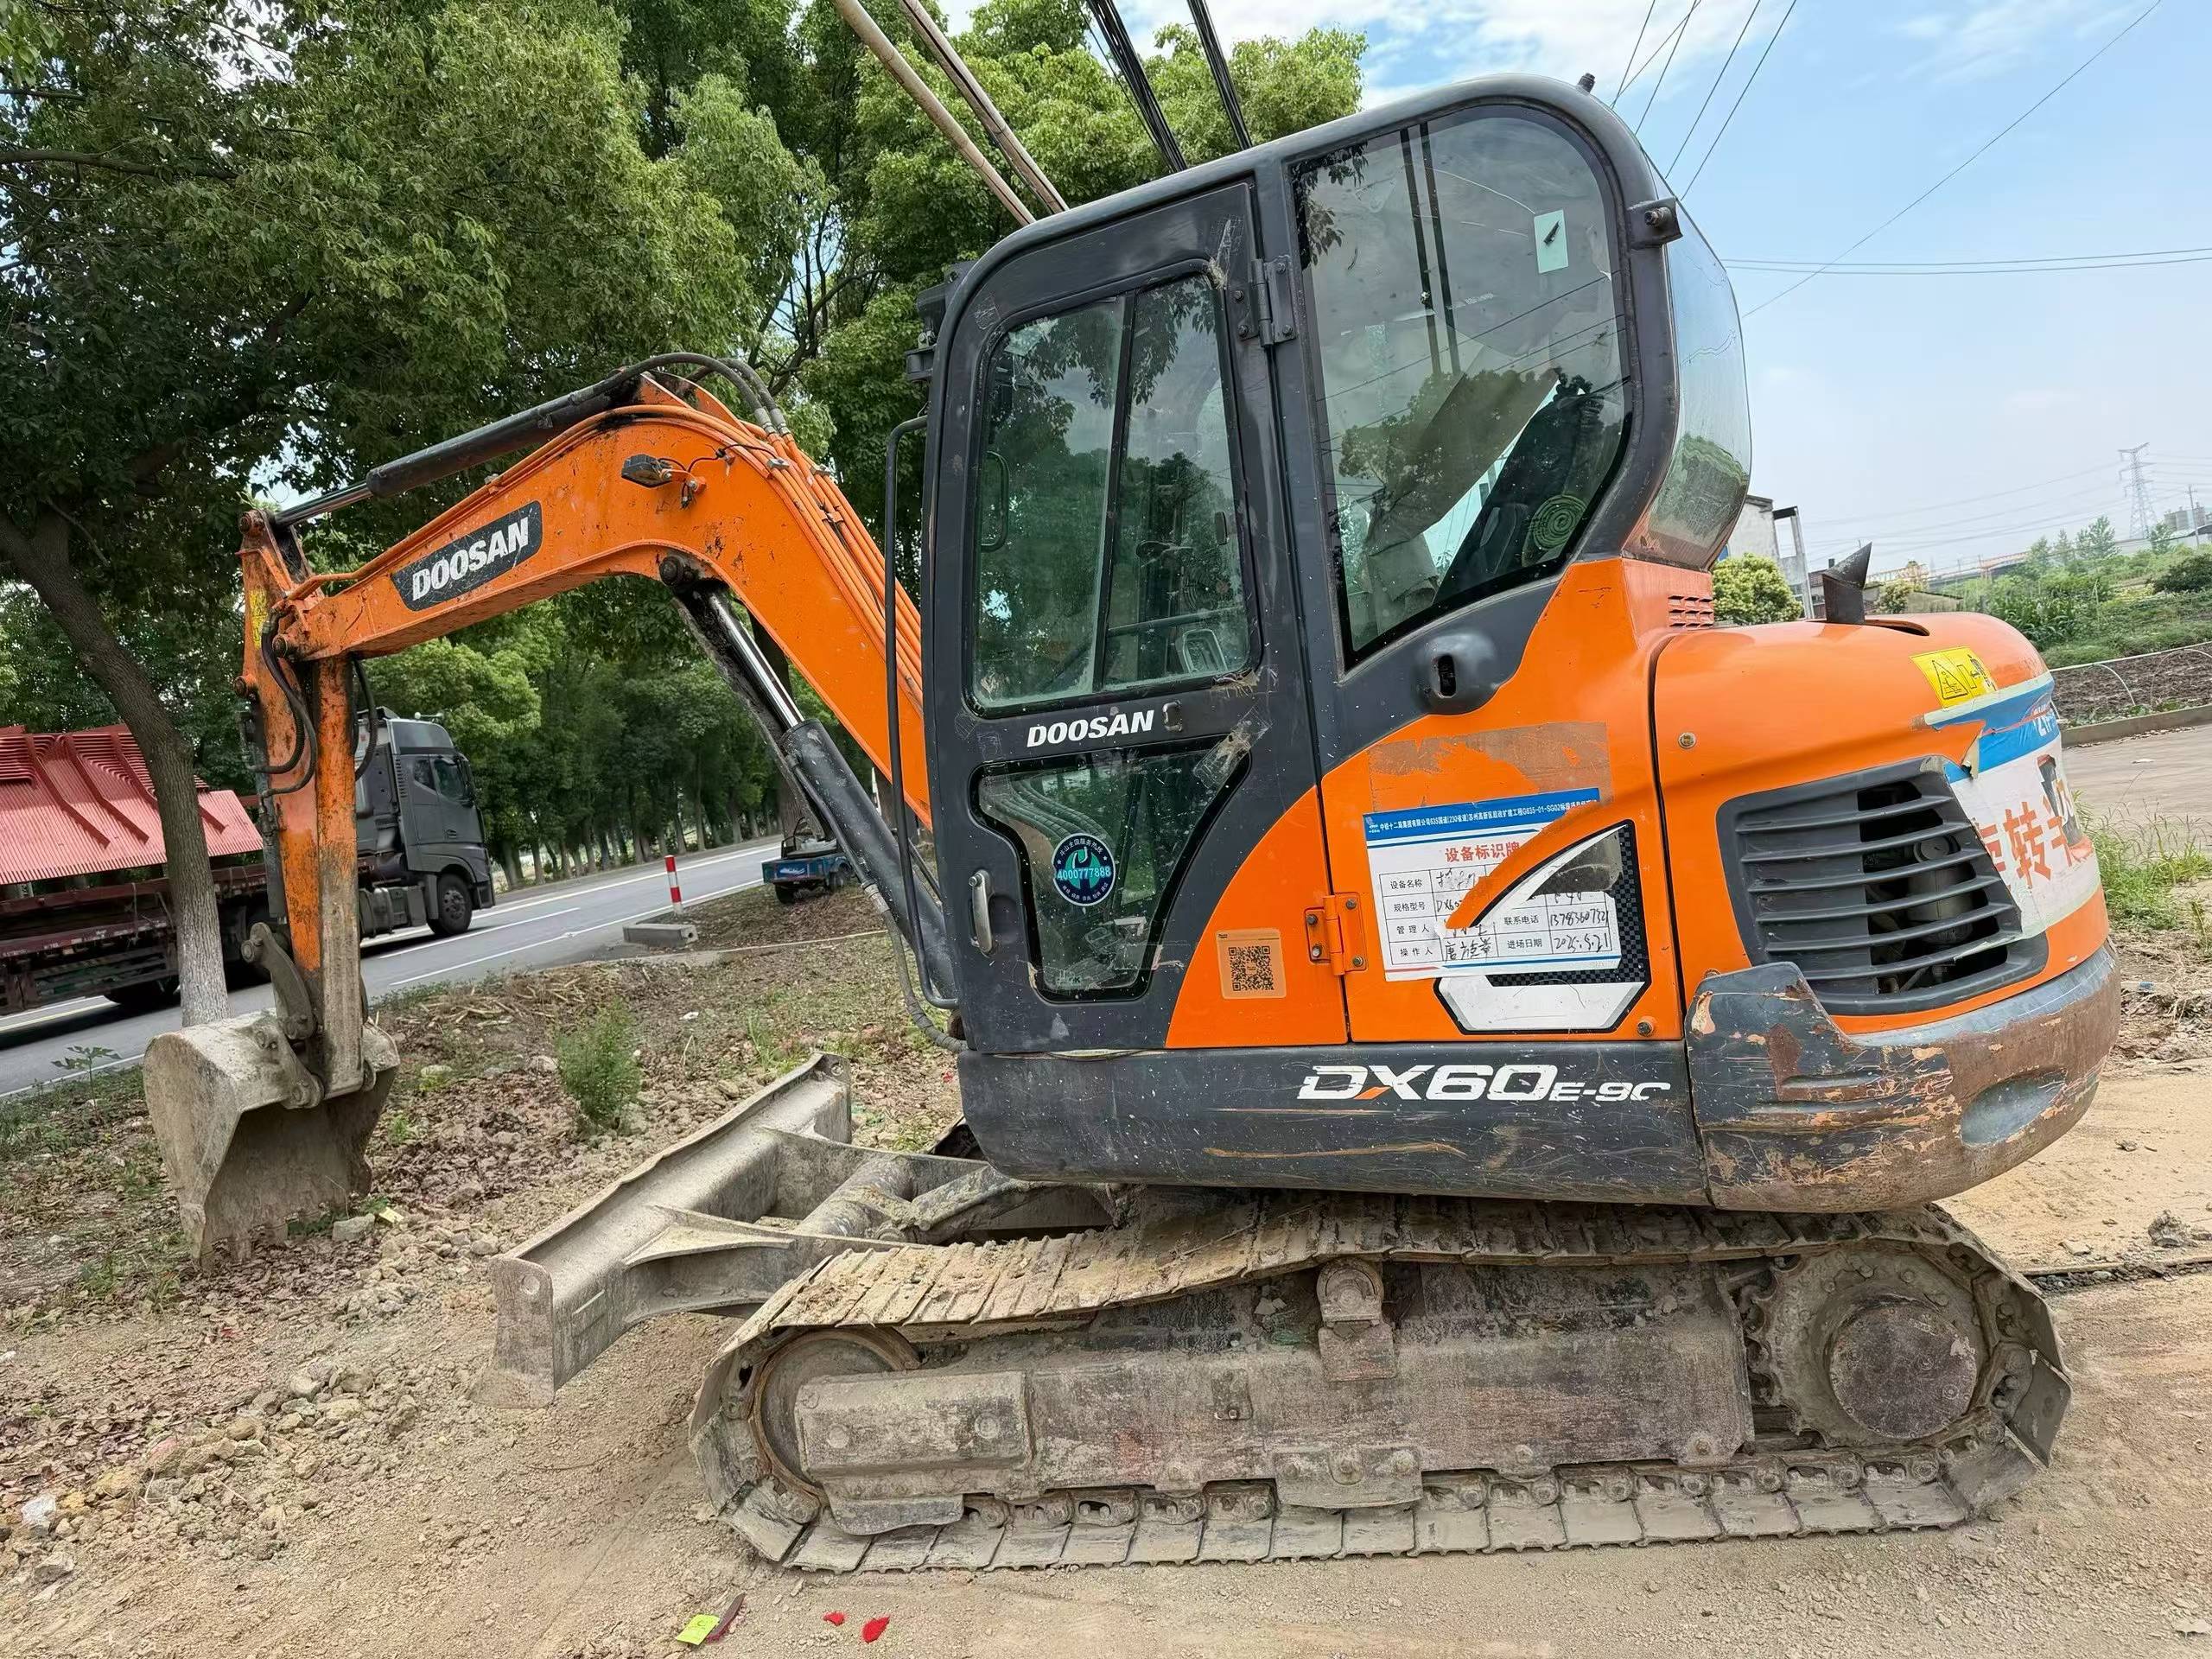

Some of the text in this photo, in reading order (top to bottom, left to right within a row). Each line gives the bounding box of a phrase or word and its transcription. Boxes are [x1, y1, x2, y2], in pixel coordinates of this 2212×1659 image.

[412, 517, 529, 601] DOOSAN
[1027, 710, 1154, 748] DOOSAN
[1057, 865, 1111, 881] 4000777888
[1390, 879, 1423, 890] 设备名称
[1394, 901, 1426, 912] 规格型号
[1503, 914, 1539, 925] 联系电话
[1396, 924, 1430, 934] 管理人
[1507, 938, 1542, 949] 进场日期
[1400, 946, 1433, 957] 操作人
